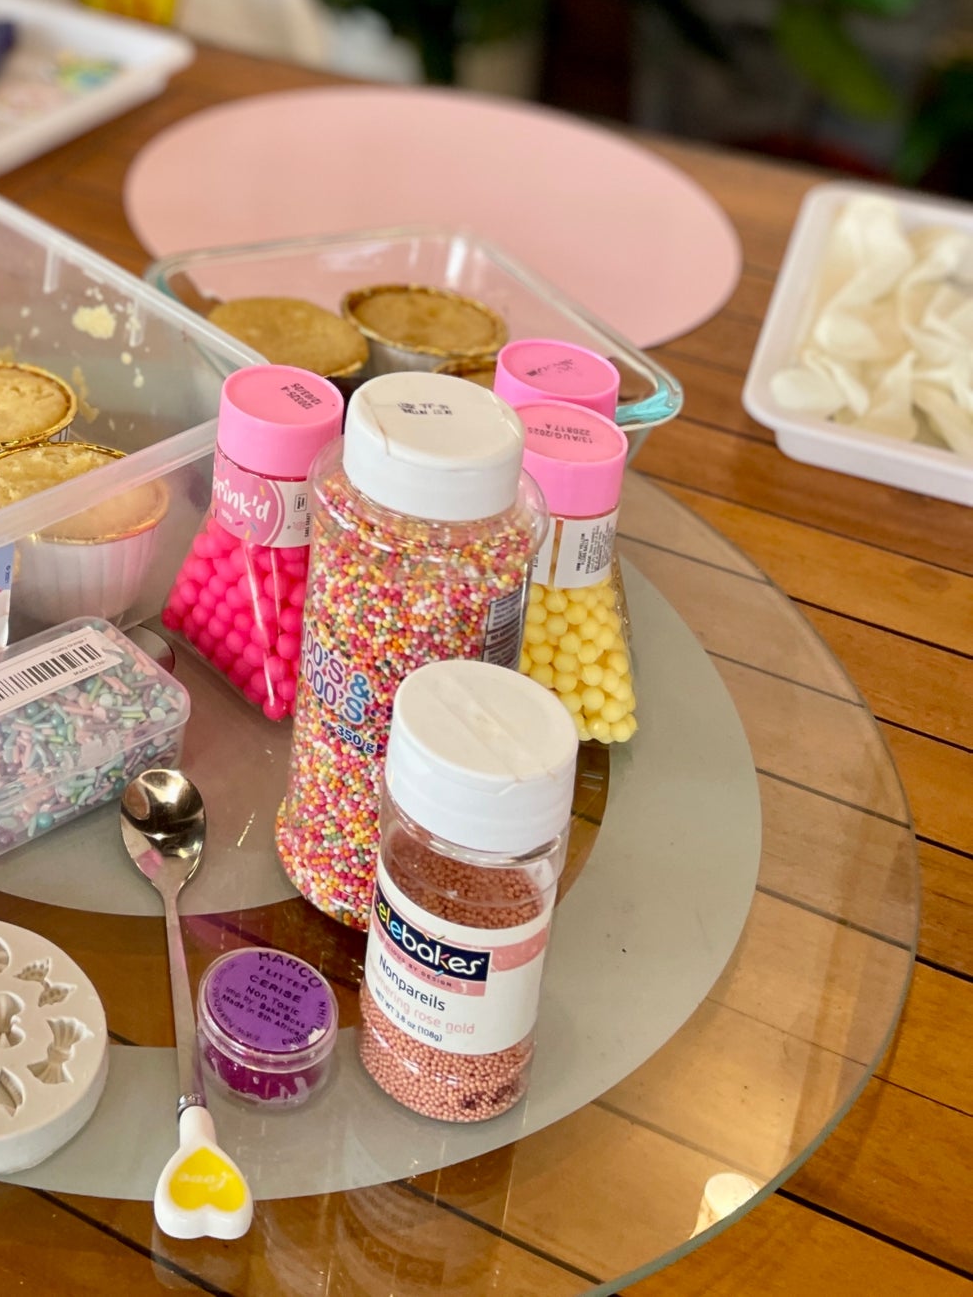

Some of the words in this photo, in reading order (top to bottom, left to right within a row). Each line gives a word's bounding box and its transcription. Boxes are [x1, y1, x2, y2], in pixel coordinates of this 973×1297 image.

[350, 673, 371, 702] &
[336, 724, 362, 745] 350
[365, 742, 374, 753] g
[376, 888, 483, 976] elebakes
[249, 974, 302, 1004] CERISE
[379, 952, 446, 1012] Nonpareils
[221, 994, 245, 1009] Made
[246, 985, 268, 1001] Non
[272, 997, 300, 1016] Toxic
[414, 1007, 442, 1028] rose
[445, 1022, 475, 1036] gold
[417, 1025, 443, 1042] (108g)
